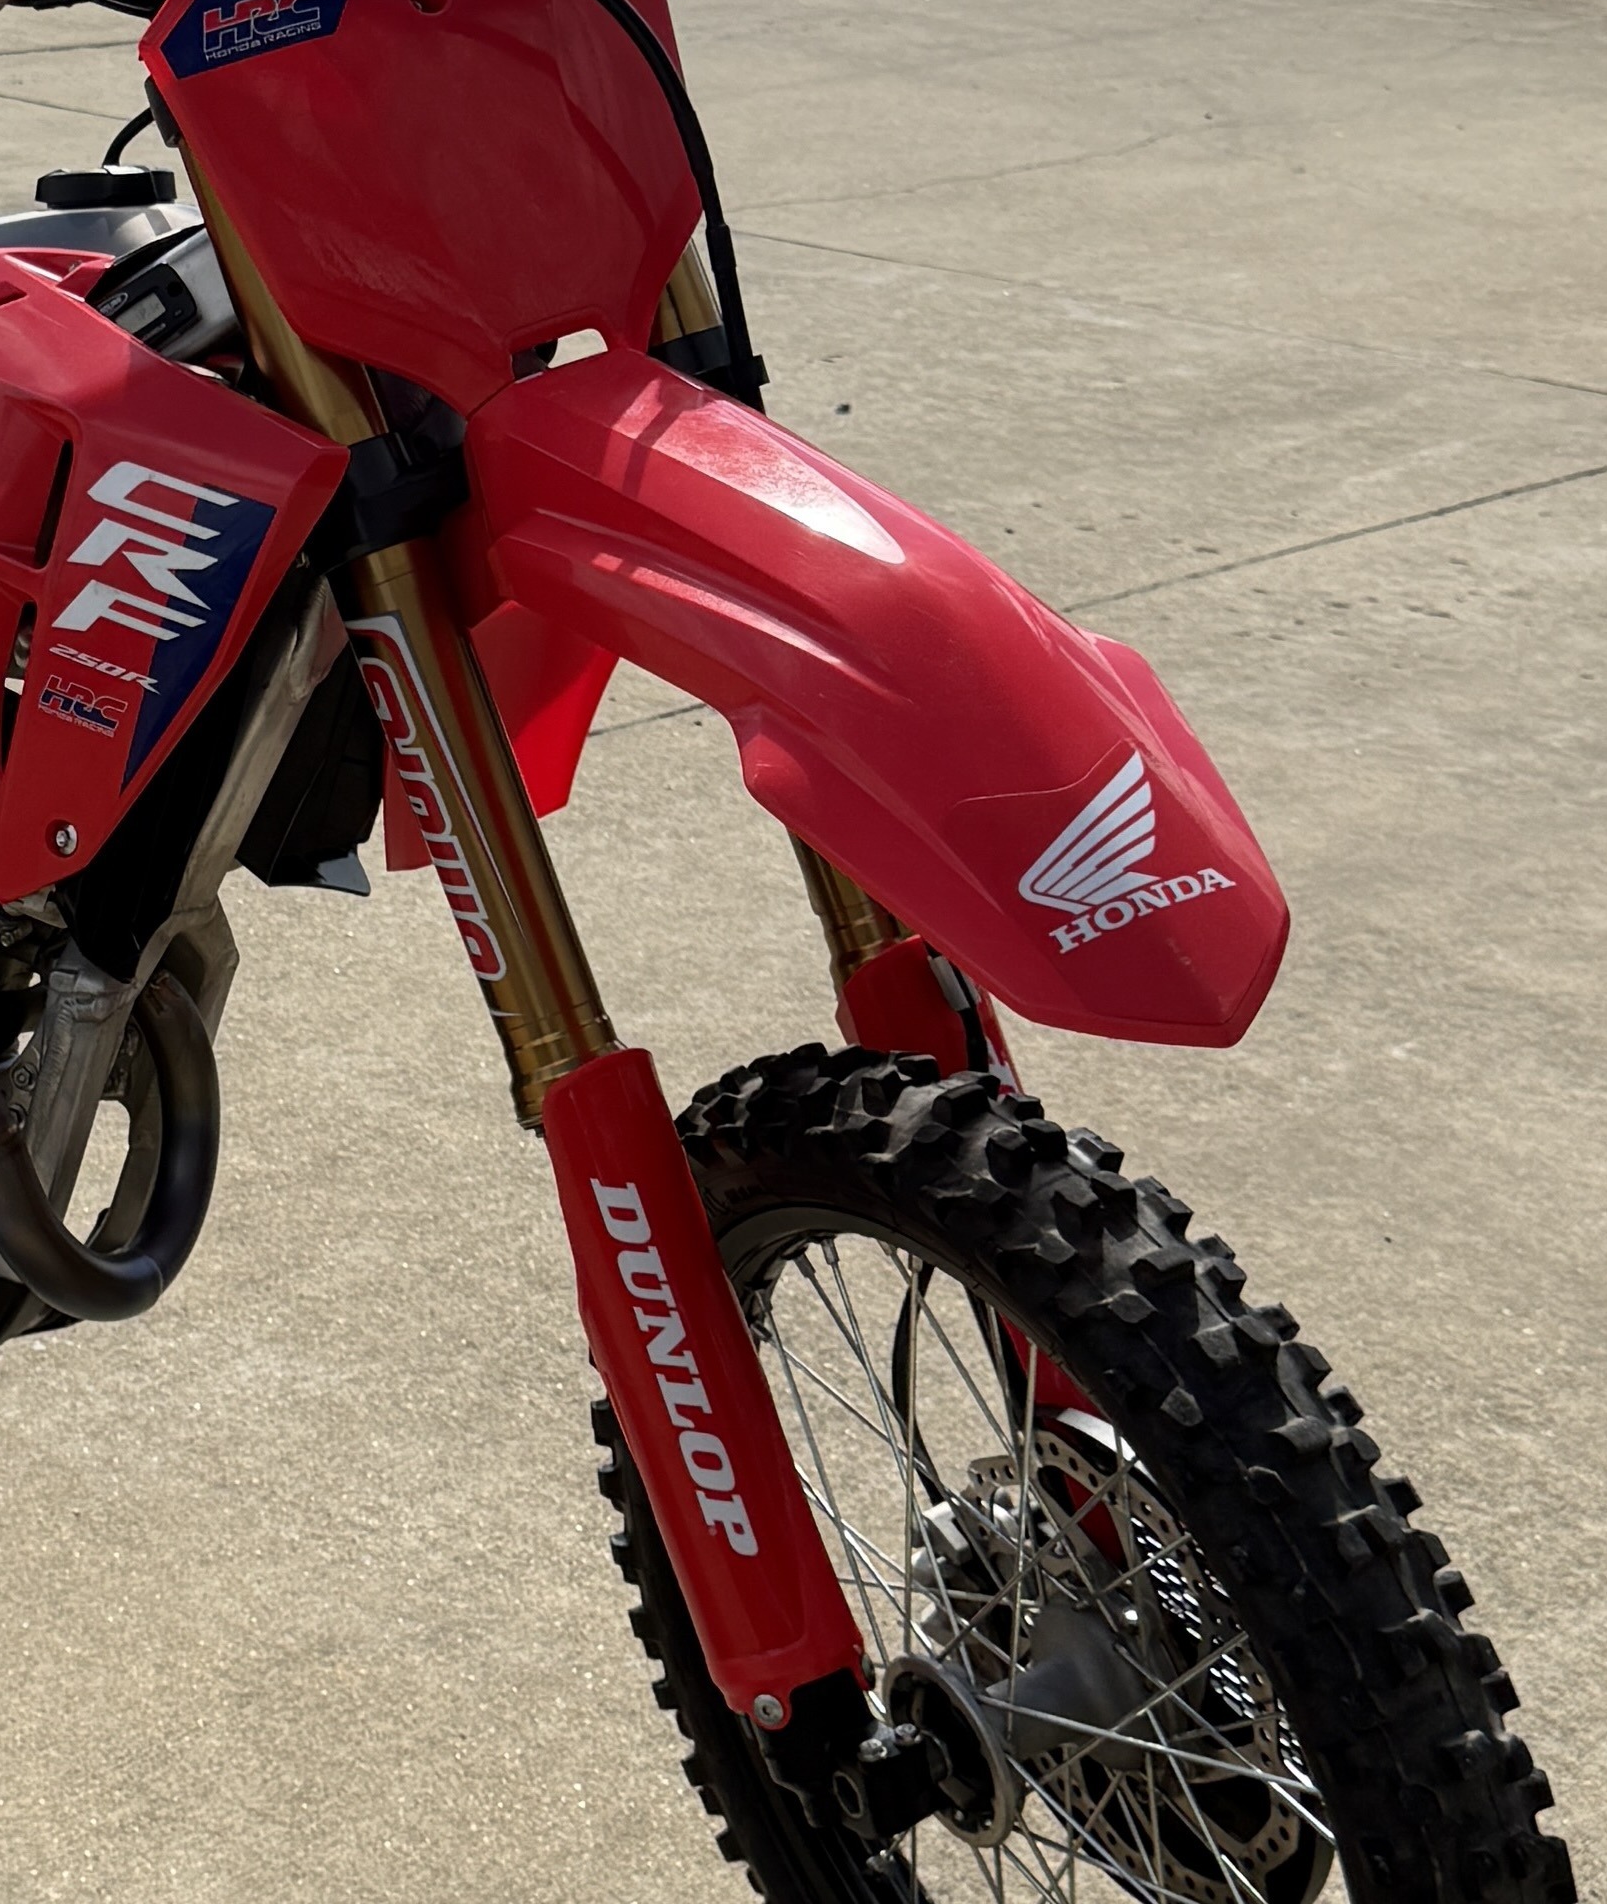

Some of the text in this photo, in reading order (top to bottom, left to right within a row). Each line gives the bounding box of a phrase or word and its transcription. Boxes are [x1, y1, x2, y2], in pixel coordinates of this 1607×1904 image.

[263, 20, 322, 45] RACING
[51, 460, 241, 642] CRF
[39, 674, 128, 732] HRC
[49, 643, 161, 696] 250R
[1049, 867, 1236, 954] HONDA
[590, 1177, 759, 1557] DUNLOP
